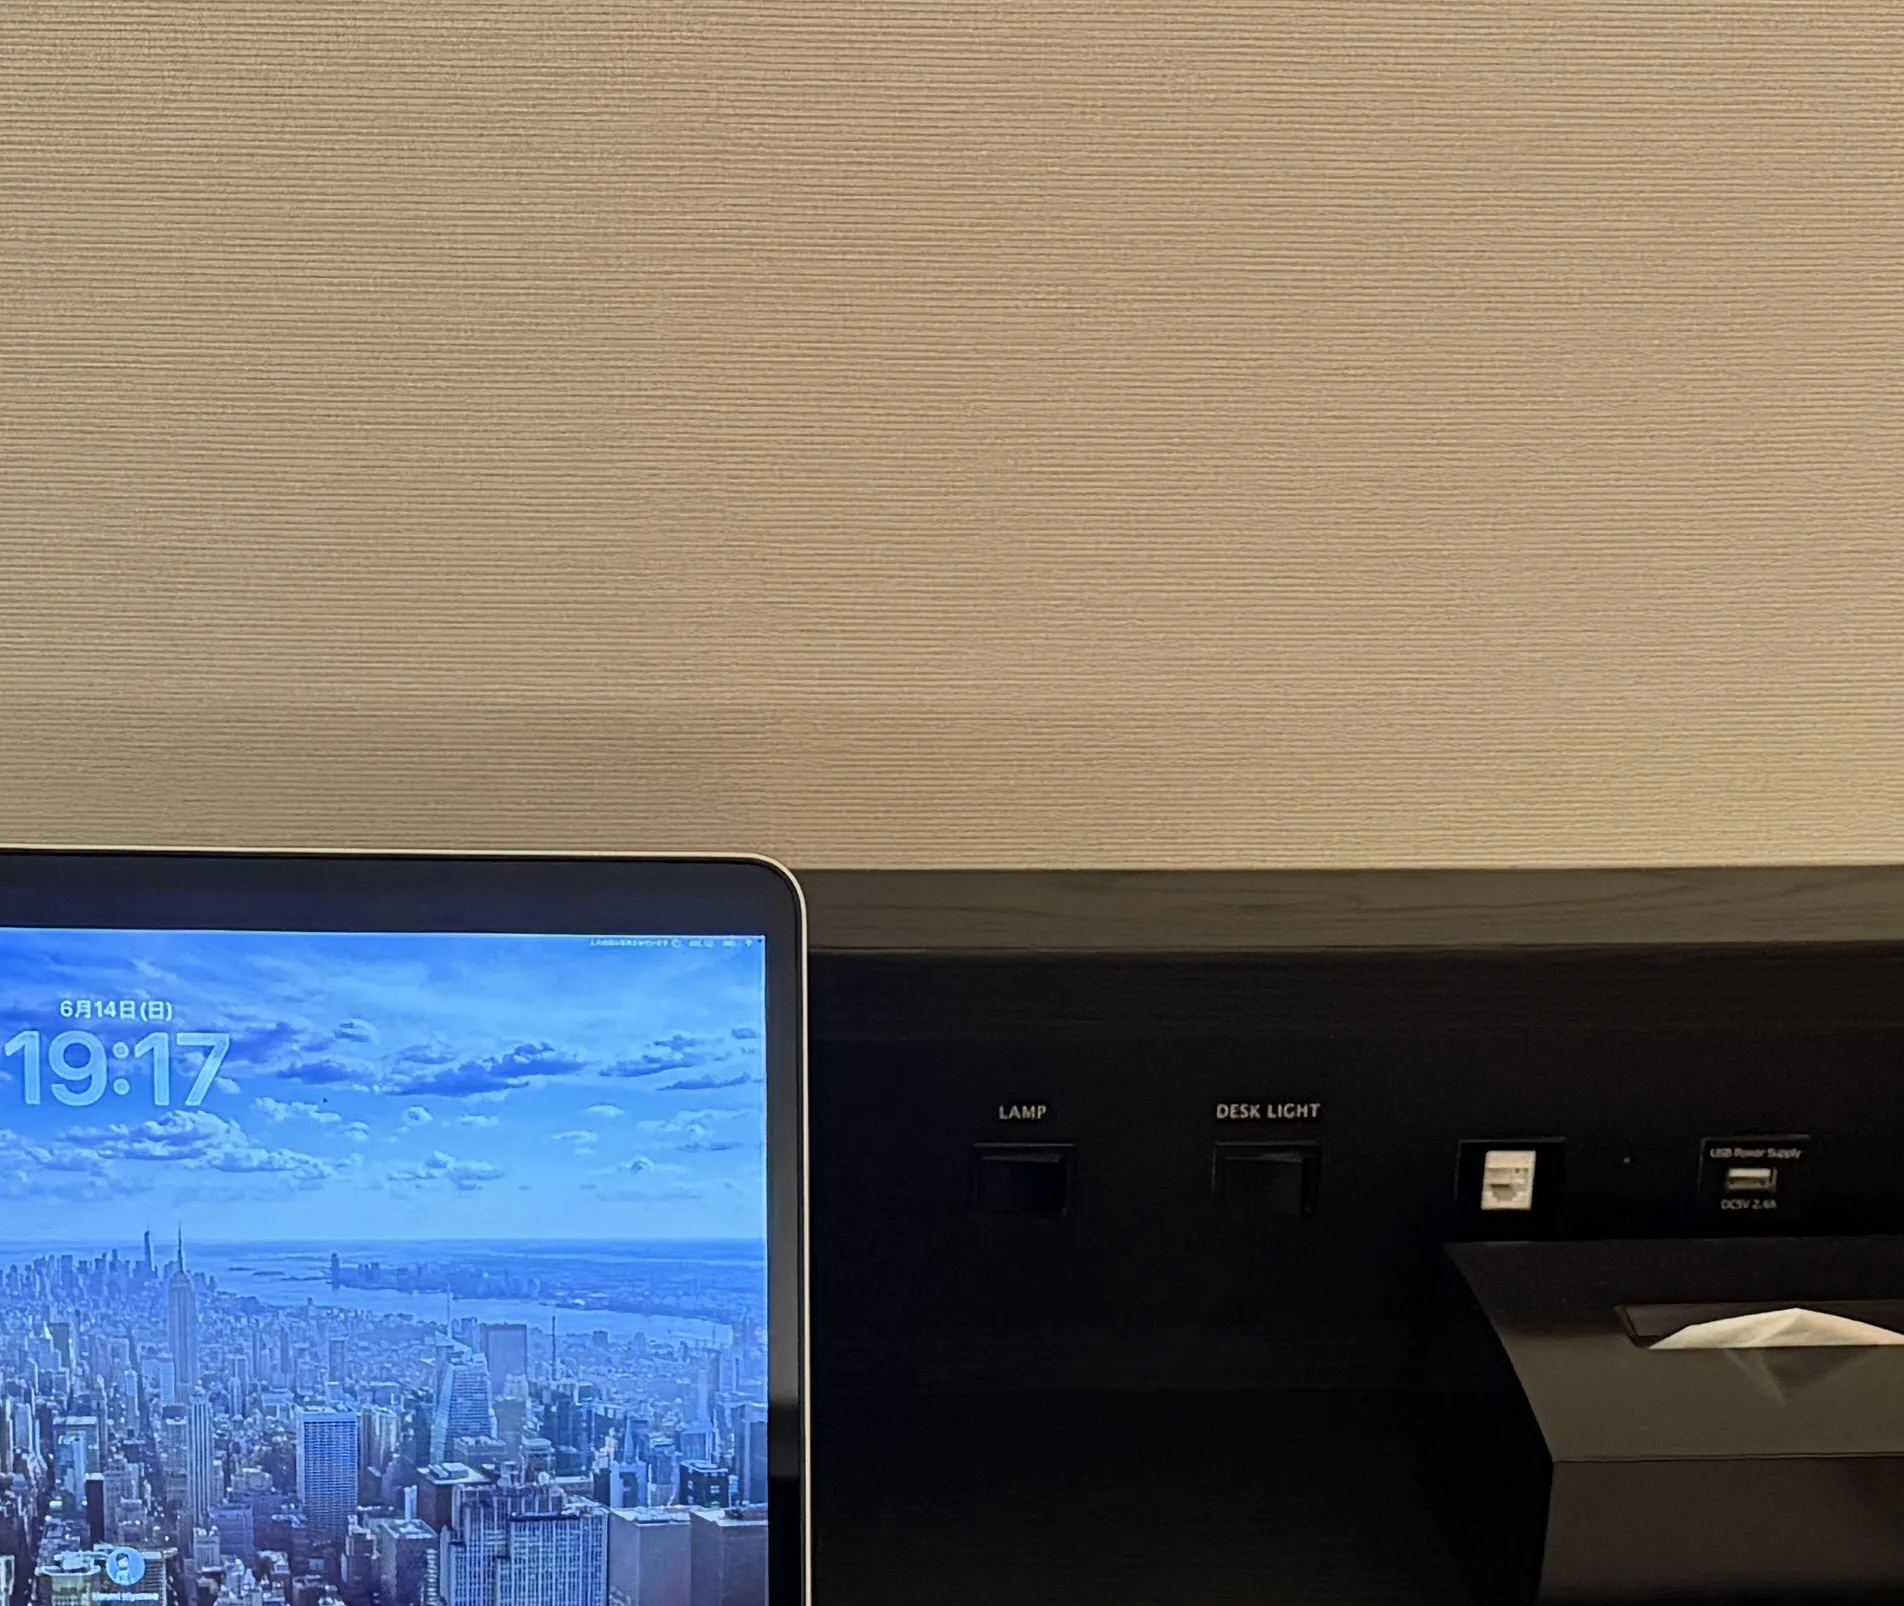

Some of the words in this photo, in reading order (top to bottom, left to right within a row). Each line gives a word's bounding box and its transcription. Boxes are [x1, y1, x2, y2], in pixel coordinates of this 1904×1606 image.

[60, 999, 173, 1022] 6月14日(日)
[4, 1029, 232, 1107] 19:17
[999, 1104, 1047, 1120] LAMP
[1216, 1103, 1261, 1119] DESK
[1267, 1102, 1321, 1119] LIGHT
[1767, 1147, 1802, 1159] Supply
